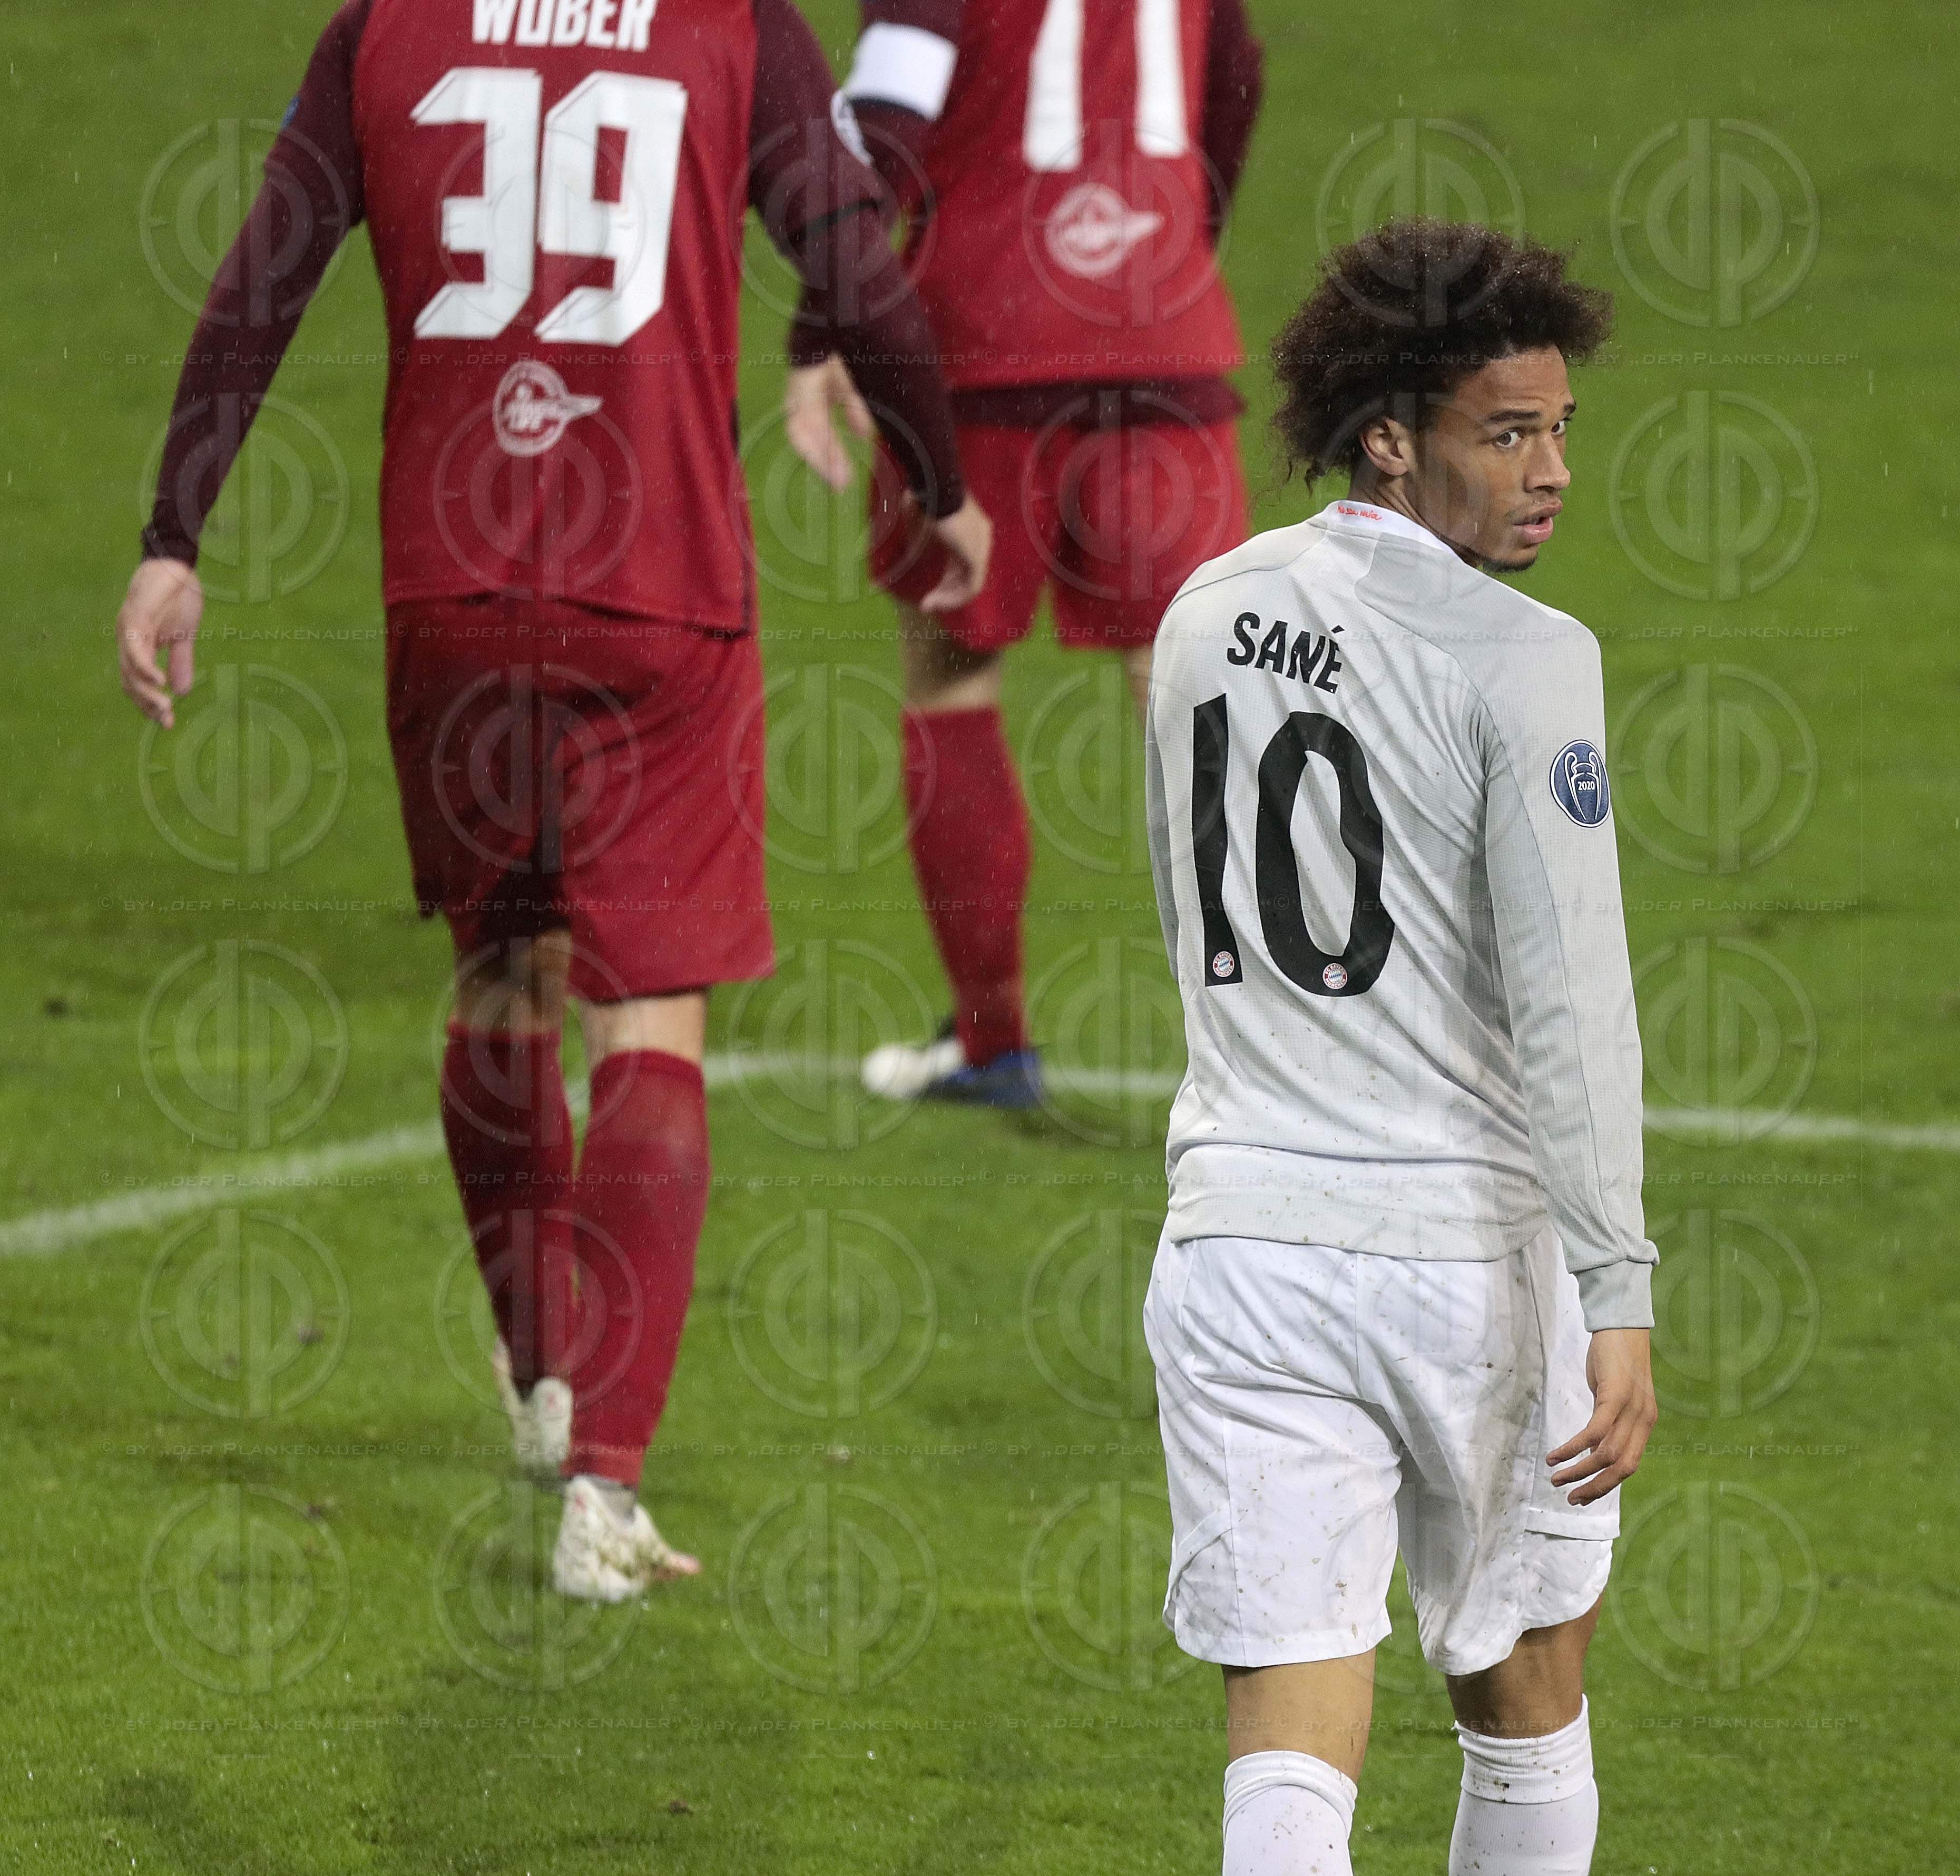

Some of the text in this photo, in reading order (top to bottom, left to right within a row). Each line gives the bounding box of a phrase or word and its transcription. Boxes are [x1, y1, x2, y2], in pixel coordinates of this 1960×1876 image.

[410, 67, 688, 347] 39
[1227, 612, 1345, 695] SANÉ
[1192, 693, 1395, 996] 10
[1577, 781, 1595, 790] 2020
